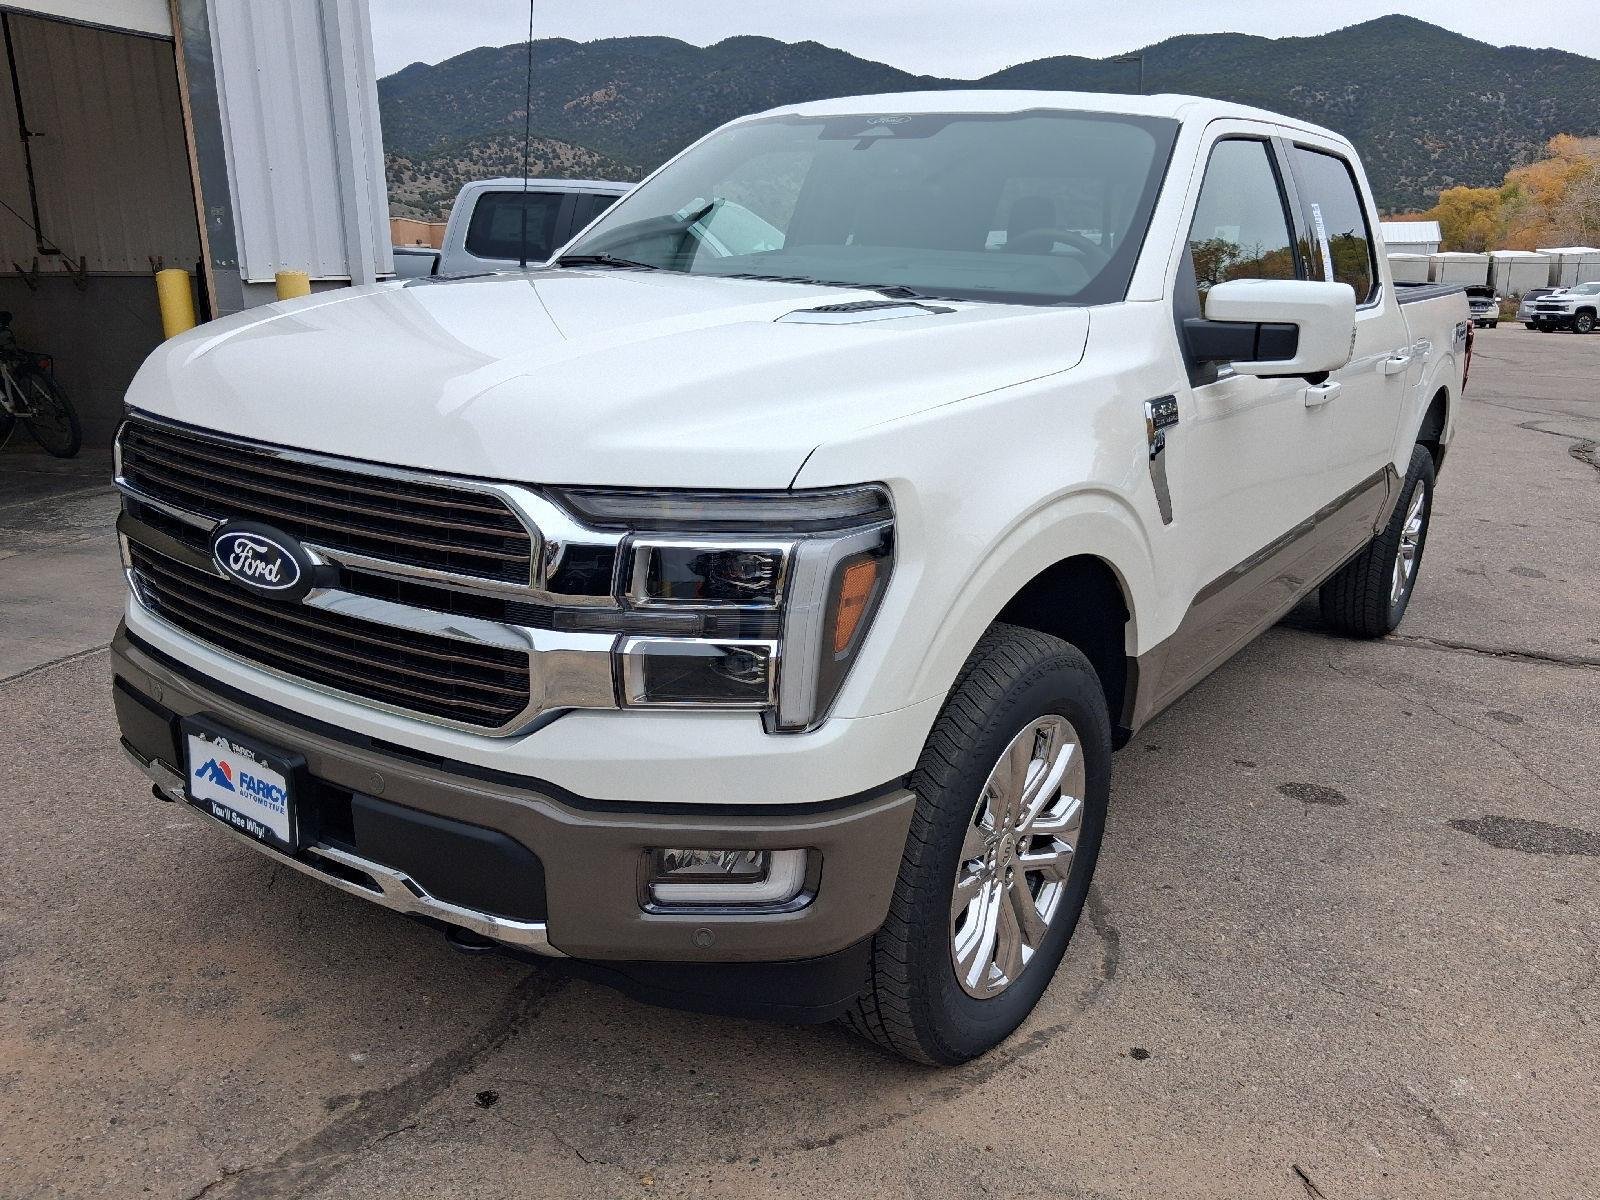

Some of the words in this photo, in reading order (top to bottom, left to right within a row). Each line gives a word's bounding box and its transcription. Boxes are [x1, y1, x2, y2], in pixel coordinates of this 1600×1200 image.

[229, 538, 282, 583] Ford
[240, 771, 288, 806] FARICY
[240, 790, 285, 815] AUTOMOTIVE
[211, 802, 231, 821] You'll
[231, 811, 245, 828] See
[246, 818, 265, 838] Why!
